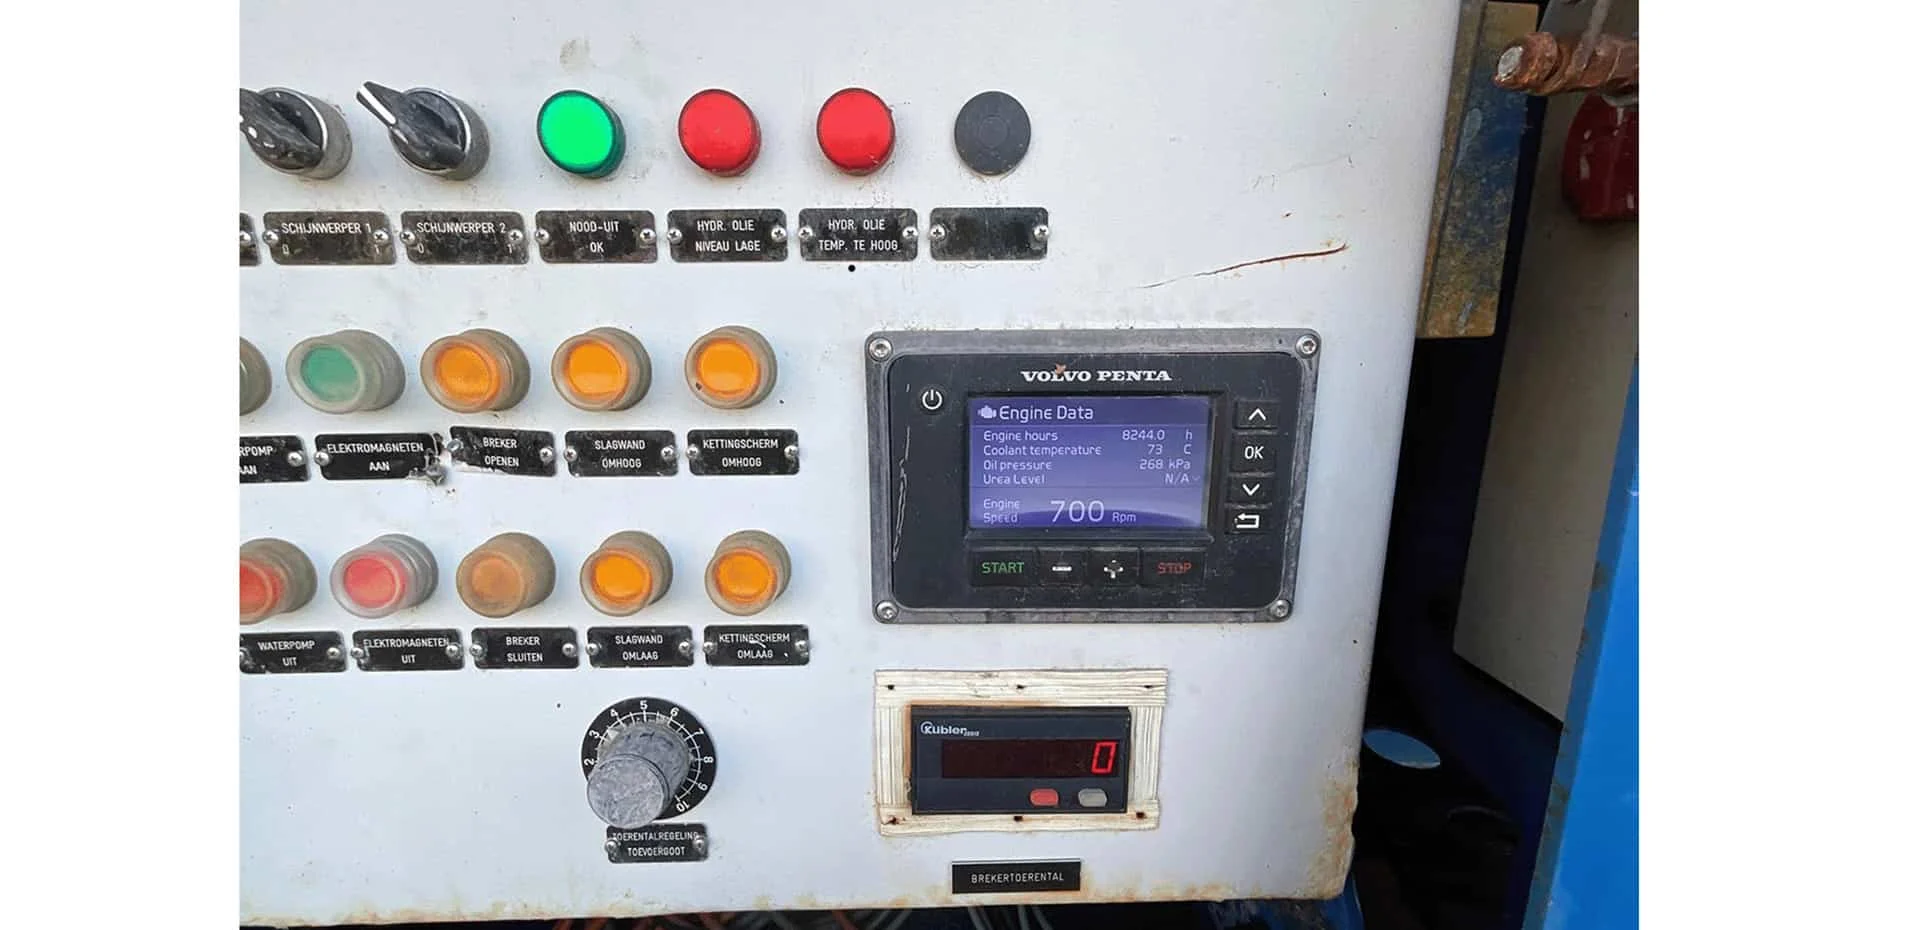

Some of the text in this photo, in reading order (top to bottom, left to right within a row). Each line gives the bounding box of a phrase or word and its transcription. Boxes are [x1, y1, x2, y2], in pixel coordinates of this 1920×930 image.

[281, 222, 372, 234] SCHIJNWERPER 1
[417, 222, 506, 233] SCHIJNWERPER 2
[569, 221, 619, 233] NOOD-UIT
[697, 220, 754, 231] HYDR. OLIE
[828, 220, 885, 231] HYDR. OLIE
[590, 242, 604, 253] OK
[695, 240, 760, 251] NIVEAU LAGE
[819, 240, 898, 251] TEMP. TE HOOG
[1021, 371, 1172, 382] VOLVO PENTA
[1000, 405, 1094, 423] Engine Data
[983, 430, 1192, 442] Engine hours 8244.0 h
[327, 443, 424, 453] ELEKTROMAGNETEN
[483, 437, 517, 449] BREKER
[595, 440, 645, 450] SLAGWAND
[703, 439, 778, 449] KETTINGSCHERM
[983, 444, 1191, 457] Coolant temperature 73 C
[1244, 446, 1264, 459] OK
[369, 461, 390, 471] AAN
[484, 455, 519, 466] OPENEN
[602, 458, 641, 469] OMHOOG
[722, 457, 762, 467] OMHOOG
[983, 459, 1191, 472] Oil pressure 268 kPa
[983, 474, 1189, 484] Urea Level N/A
[983, 500, 1020, 511] Engine
[1050, 501, 1136, 523] 700 Rpm
[983, 513, 1018, 524] Speed
[982, 562, 1024, 574] START
[1158, 562, 1191, 574] STOP
[506, 636, 540, 646] BREKER
[615, 635, 663, 644] SLAGWAND
[719, 634, 790, 643] KETTINGSCHERM
[258, 641, 315, 651] WATERPOMP
[401, 654, 416, 664] UIT
[507, 653, 543, 663] SLUITEN
[623, 651, 658, 661] OMLAAG
[737, 650, 773, 659] OMLAAG
[283, 656, 297, 666] UIT
[640, 700, 647, 709] 5
[671, 707, 679, 716] 6
[589, 730, 600, 739] 3
[584, 758, 595, 766] 2
[1091, 742, 1116, 773] 0
[698, 783, 708, 791] 9
[676, 801, 690, 812] 10
[627, 846, 686, 857] TOEVOERGOOT
[971, 872, 1064, 883] BREKERTOERENTAL
